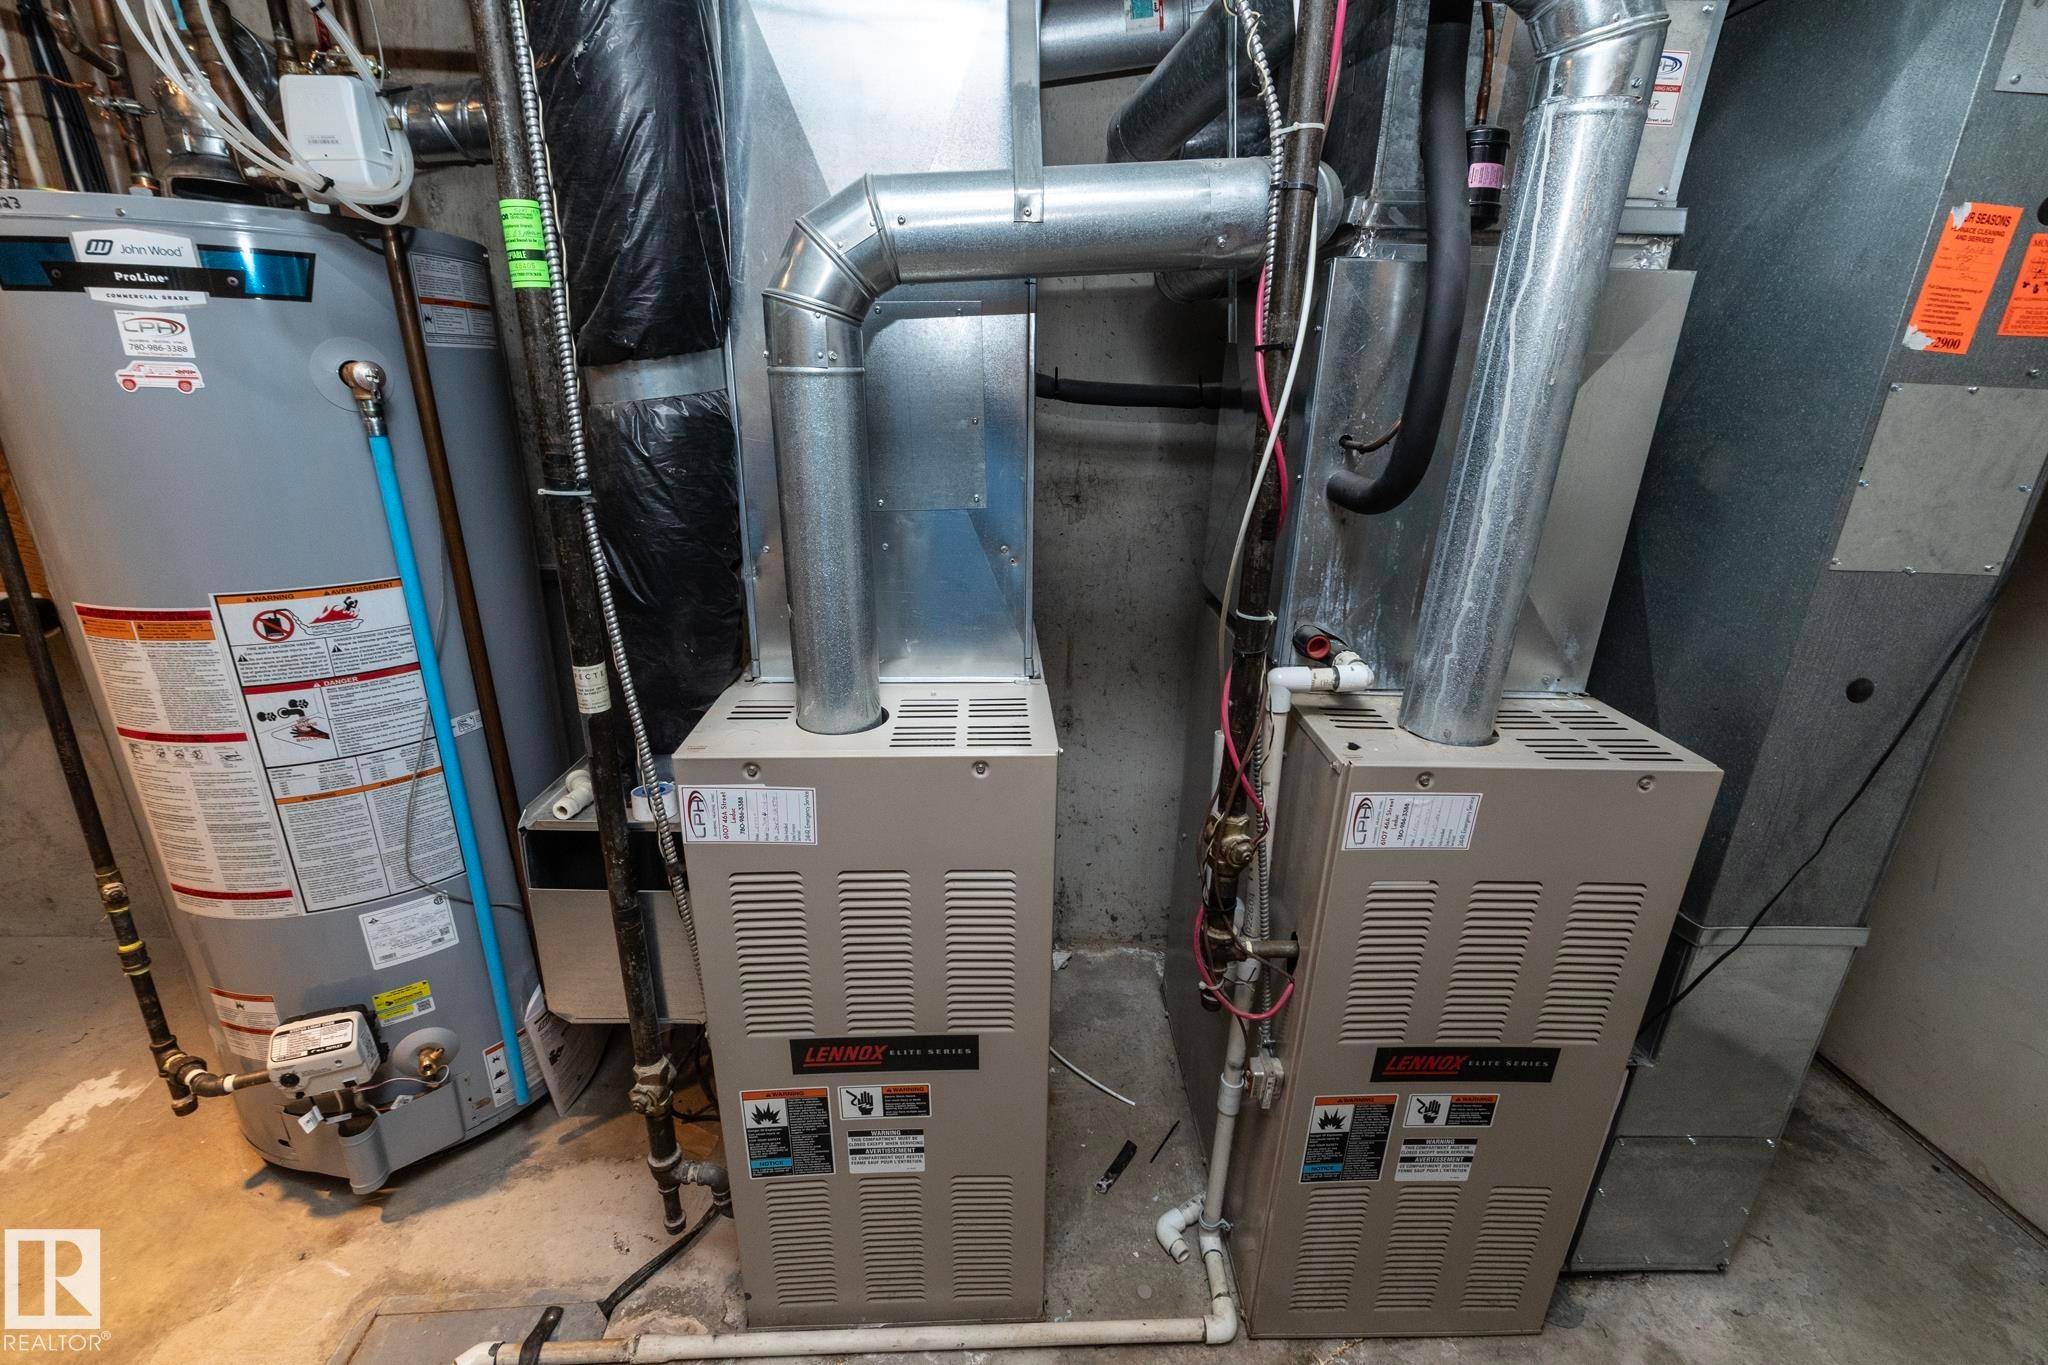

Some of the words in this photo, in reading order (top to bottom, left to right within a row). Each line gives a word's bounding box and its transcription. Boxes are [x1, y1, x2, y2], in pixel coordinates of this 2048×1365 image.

[1976, 212, 2012, 227] SEASONS
[1968, 236, 1996, 244] SERVICES
[1977, 228, 2006, 237] CLEANING
[120, 244, 146, 255] John
[148, 246, 182, 257] Wood
[129, 344, 188, 353] 780-986-3388
[252, 594, 294, 602] WARNING
[330, 582, 393, 595] AVERTISSEMENT
[323, 676, 359, 687] DANGER
[1387, 798, 1395, 816] Street
[738, 797, 746, 834] 780-986-3388
[1391, 814, 1399, 830] Leduc
[805, 1045, 888, 1063] LENNOX
[1385, 1055, 1469, 1071] LENNOX
